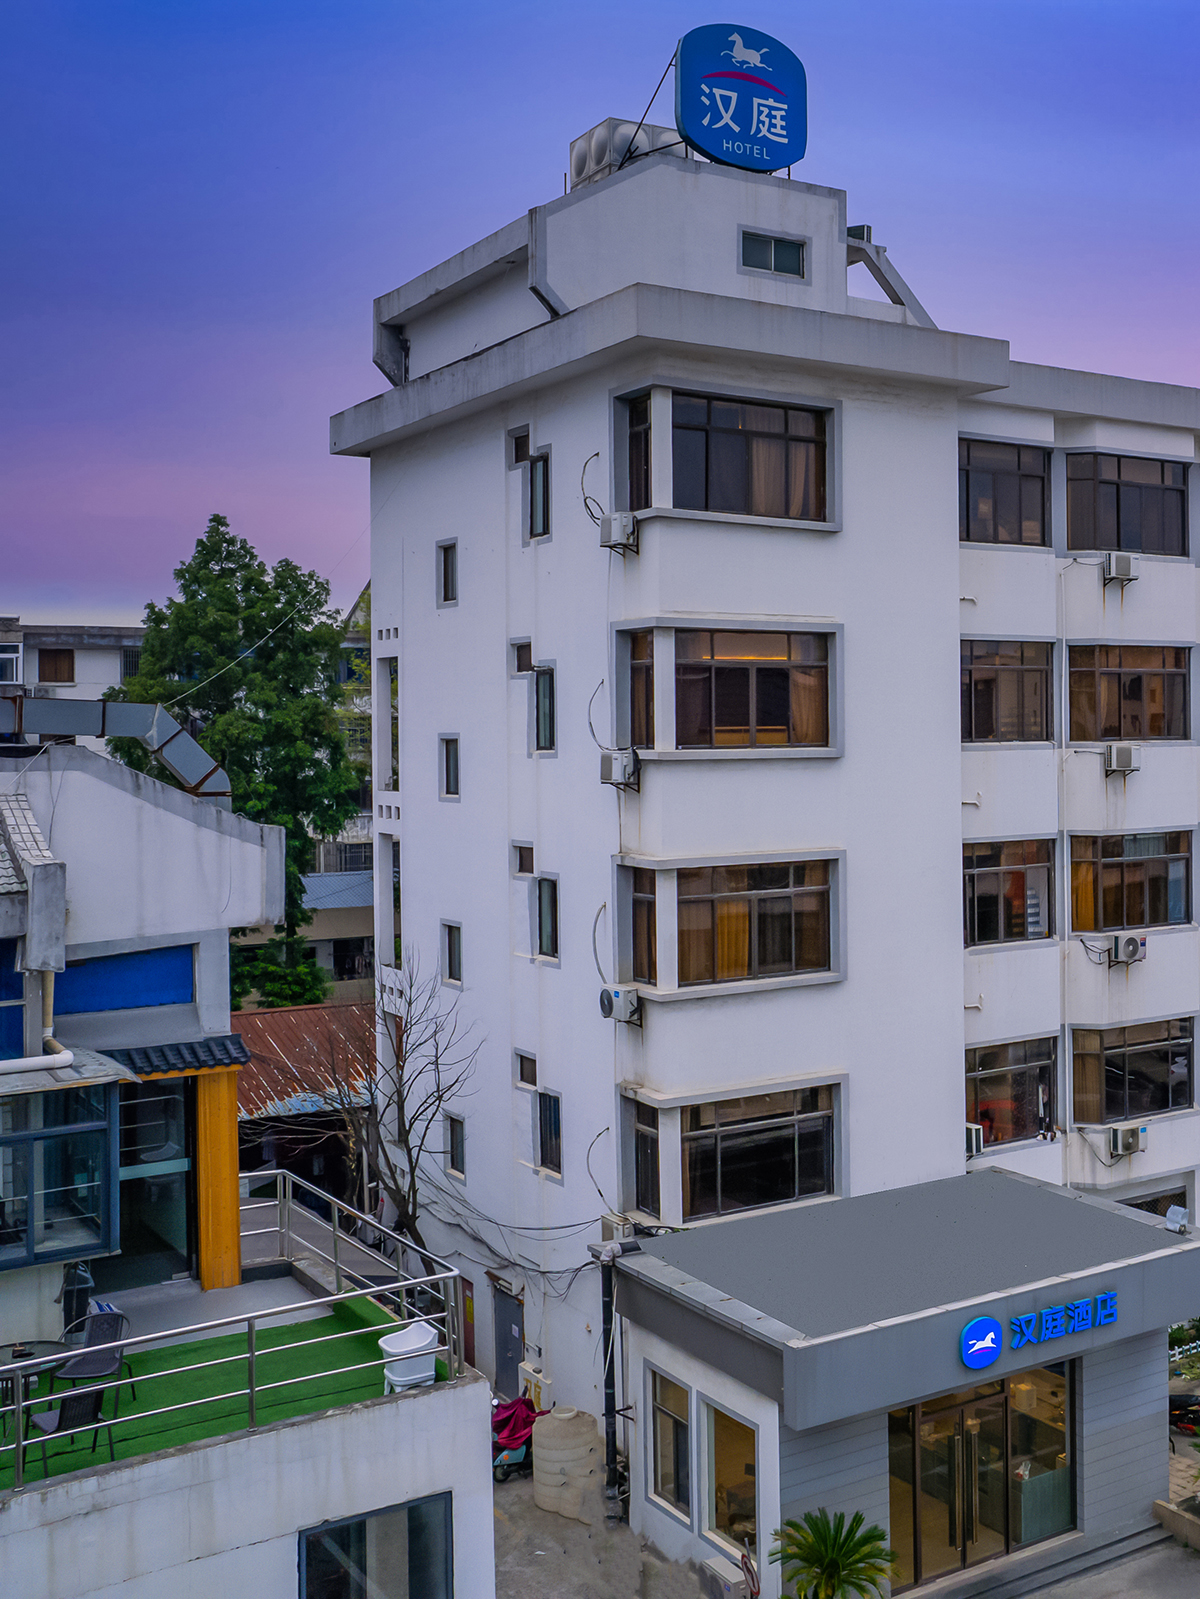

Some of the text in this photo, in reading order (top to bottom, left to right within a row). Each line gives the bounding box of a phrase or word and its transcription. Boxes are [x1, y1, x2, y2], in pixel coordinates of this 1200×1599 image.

[700, 83, 789, 144] 汉庭
[723, 138, 771, 160] HOTEL
[1009, 1290, 1118, 1350] 汉庭酒店
